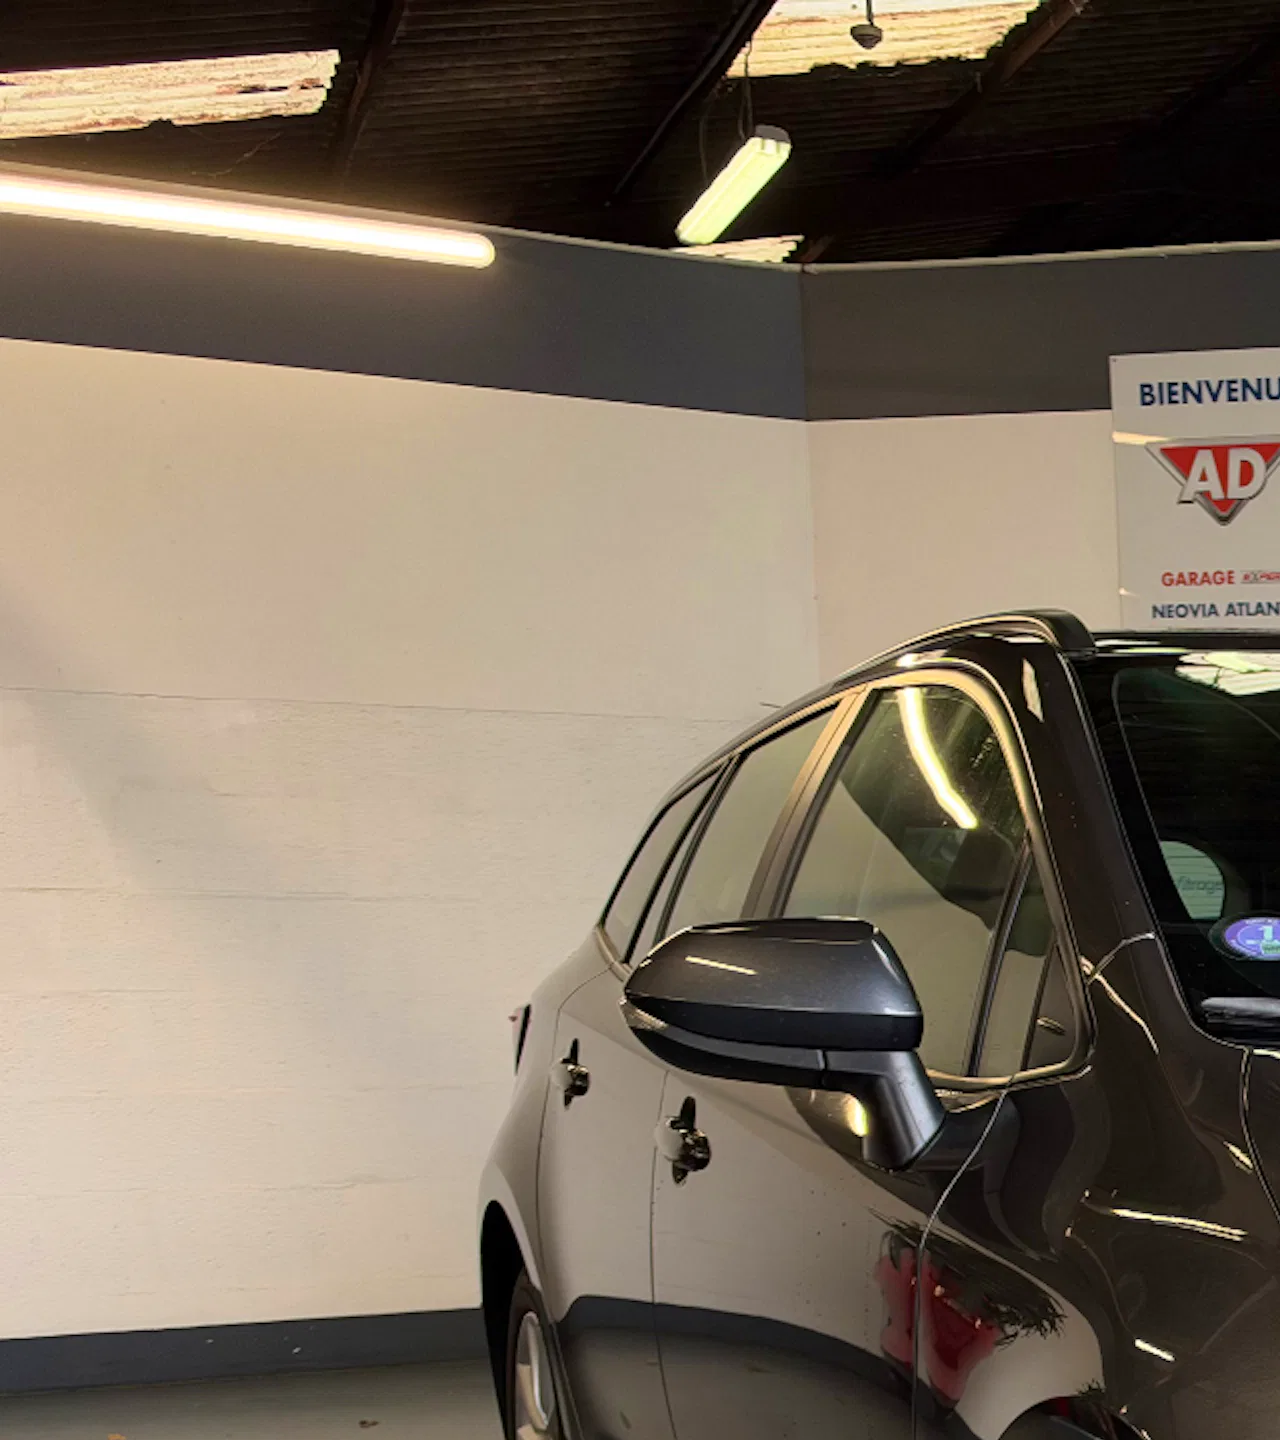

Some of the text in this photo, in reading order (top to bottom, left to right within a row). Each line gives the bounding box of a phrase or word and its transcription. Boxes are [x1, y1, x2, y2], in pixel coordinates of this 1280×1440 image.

[1178, 447, 1267, 504] AD
[1161, 570, 1235, 586] GARAGE
[1152, 603, 1219, 619] NEOVIA
